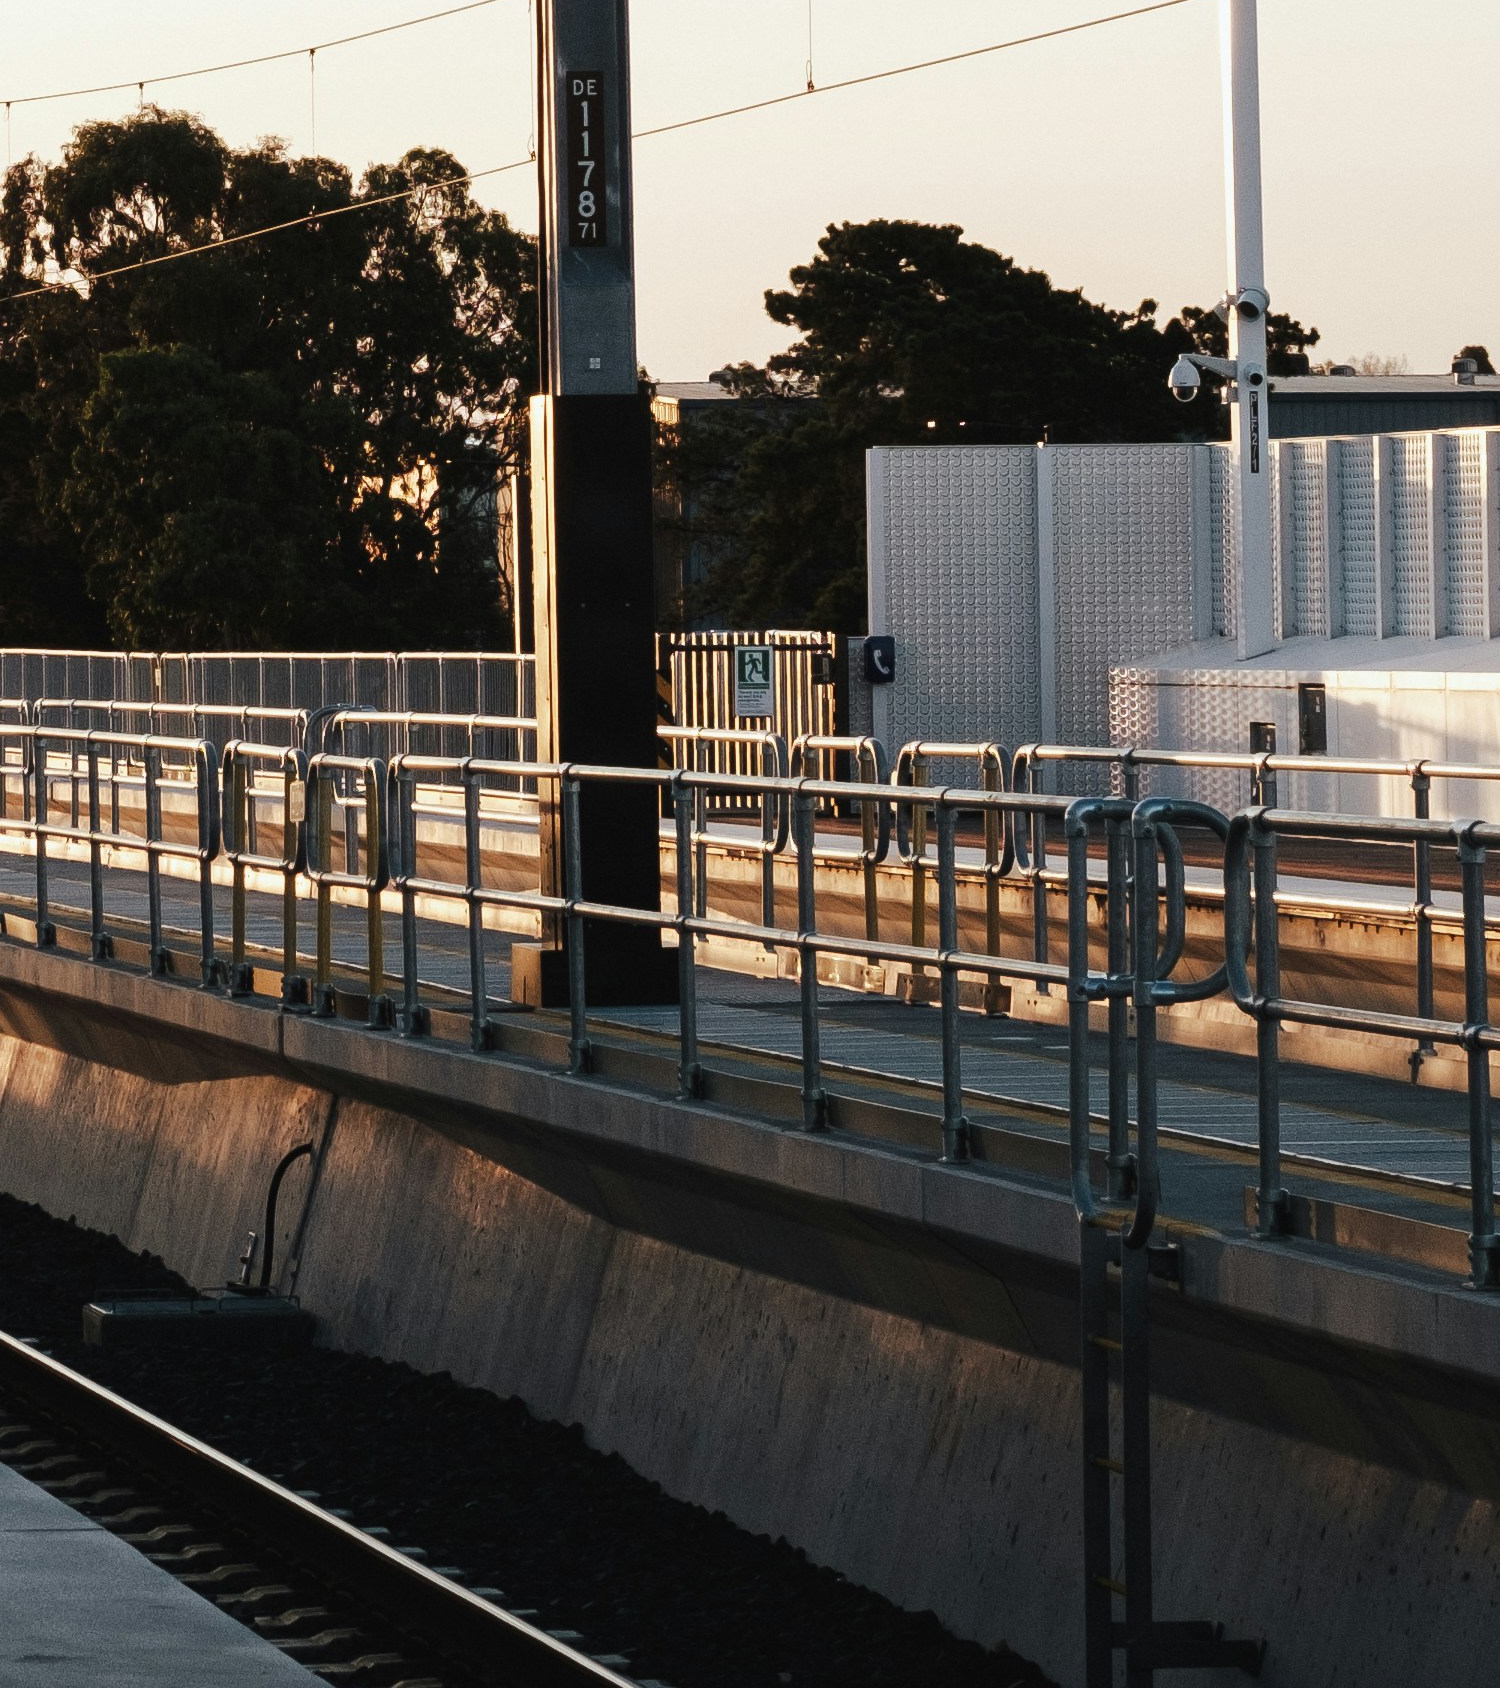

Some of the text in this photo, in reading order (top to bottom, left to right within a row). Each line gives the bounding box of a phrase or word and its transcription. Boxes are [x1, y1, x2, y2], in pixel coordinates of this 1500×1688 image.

[573, 80, 597, 95] DE
[578, 101, 596, 217] 1178
[578, 223, 596, 238] 71
